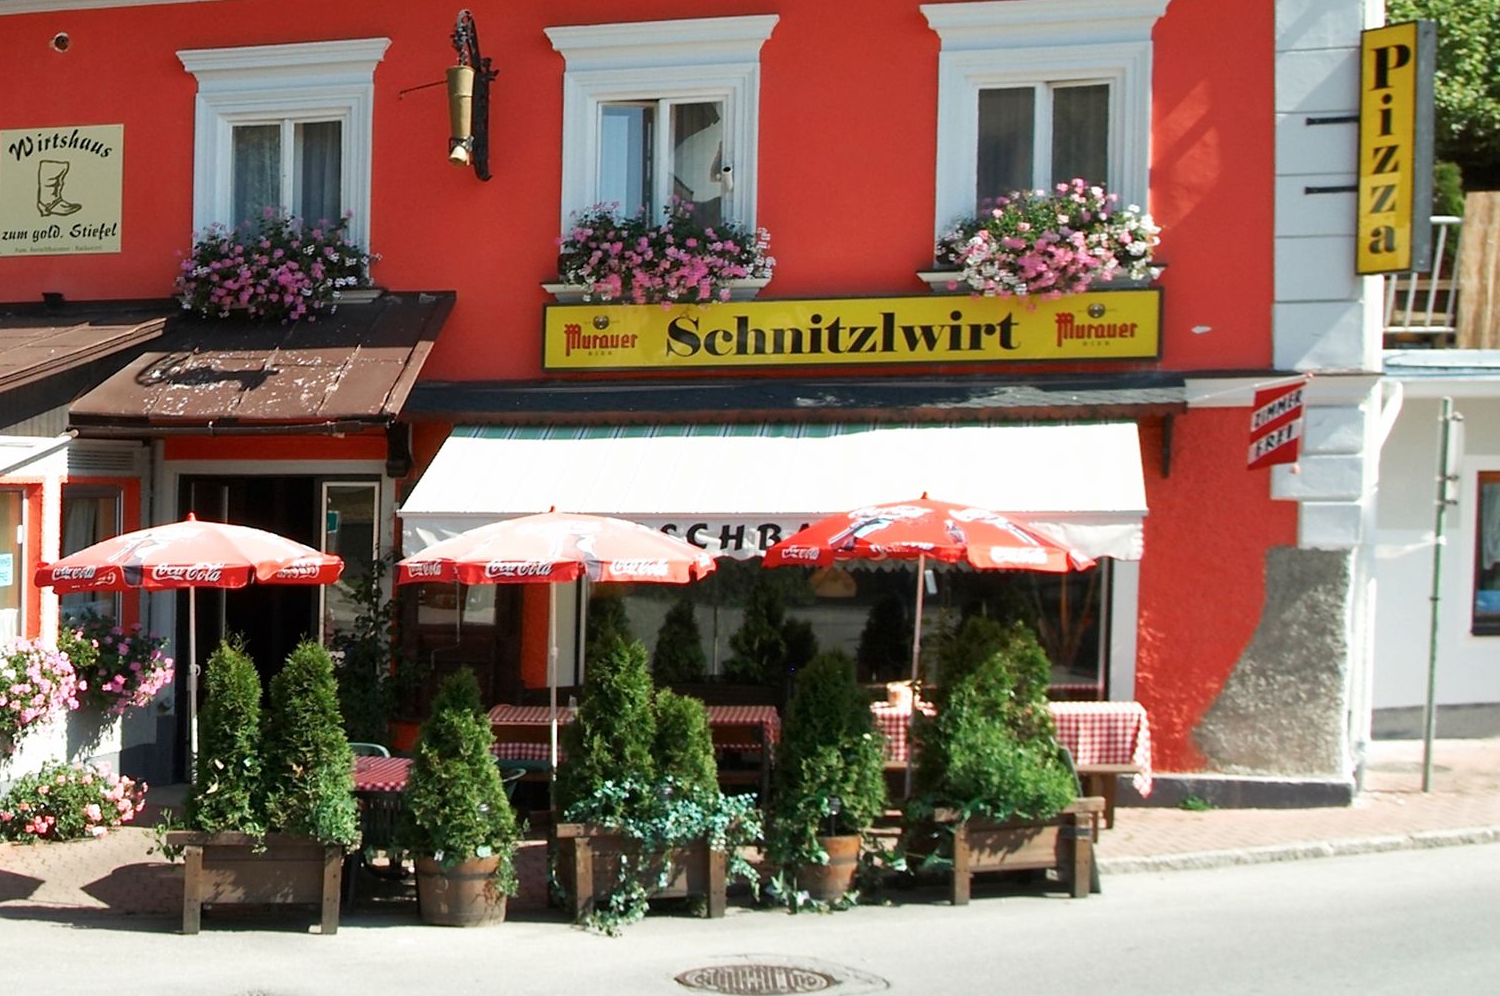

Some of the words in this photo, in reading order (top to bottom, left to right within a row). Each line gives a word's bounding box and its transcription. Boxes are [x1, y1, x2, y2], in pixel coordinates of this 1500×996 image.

[8, 128, 113, 162] Wirtshaus
[1367, 42, 1412, 255] Pizza
[1, 229, 28, 241] zum
[32, 224, 64, 243] gold.
[69, 222, 118, 241] Stiefel
[563, 322, 639, 357] Murauer
[665, 309, 1022, 358] Schnitzlwirt
[1055, 312, 1139, 347] Murauer
[1255, 390, 1303, 428] ZIMMER
[1255, 424, 1293, 458] FREI
[660, 523, 810, 551] CHB
